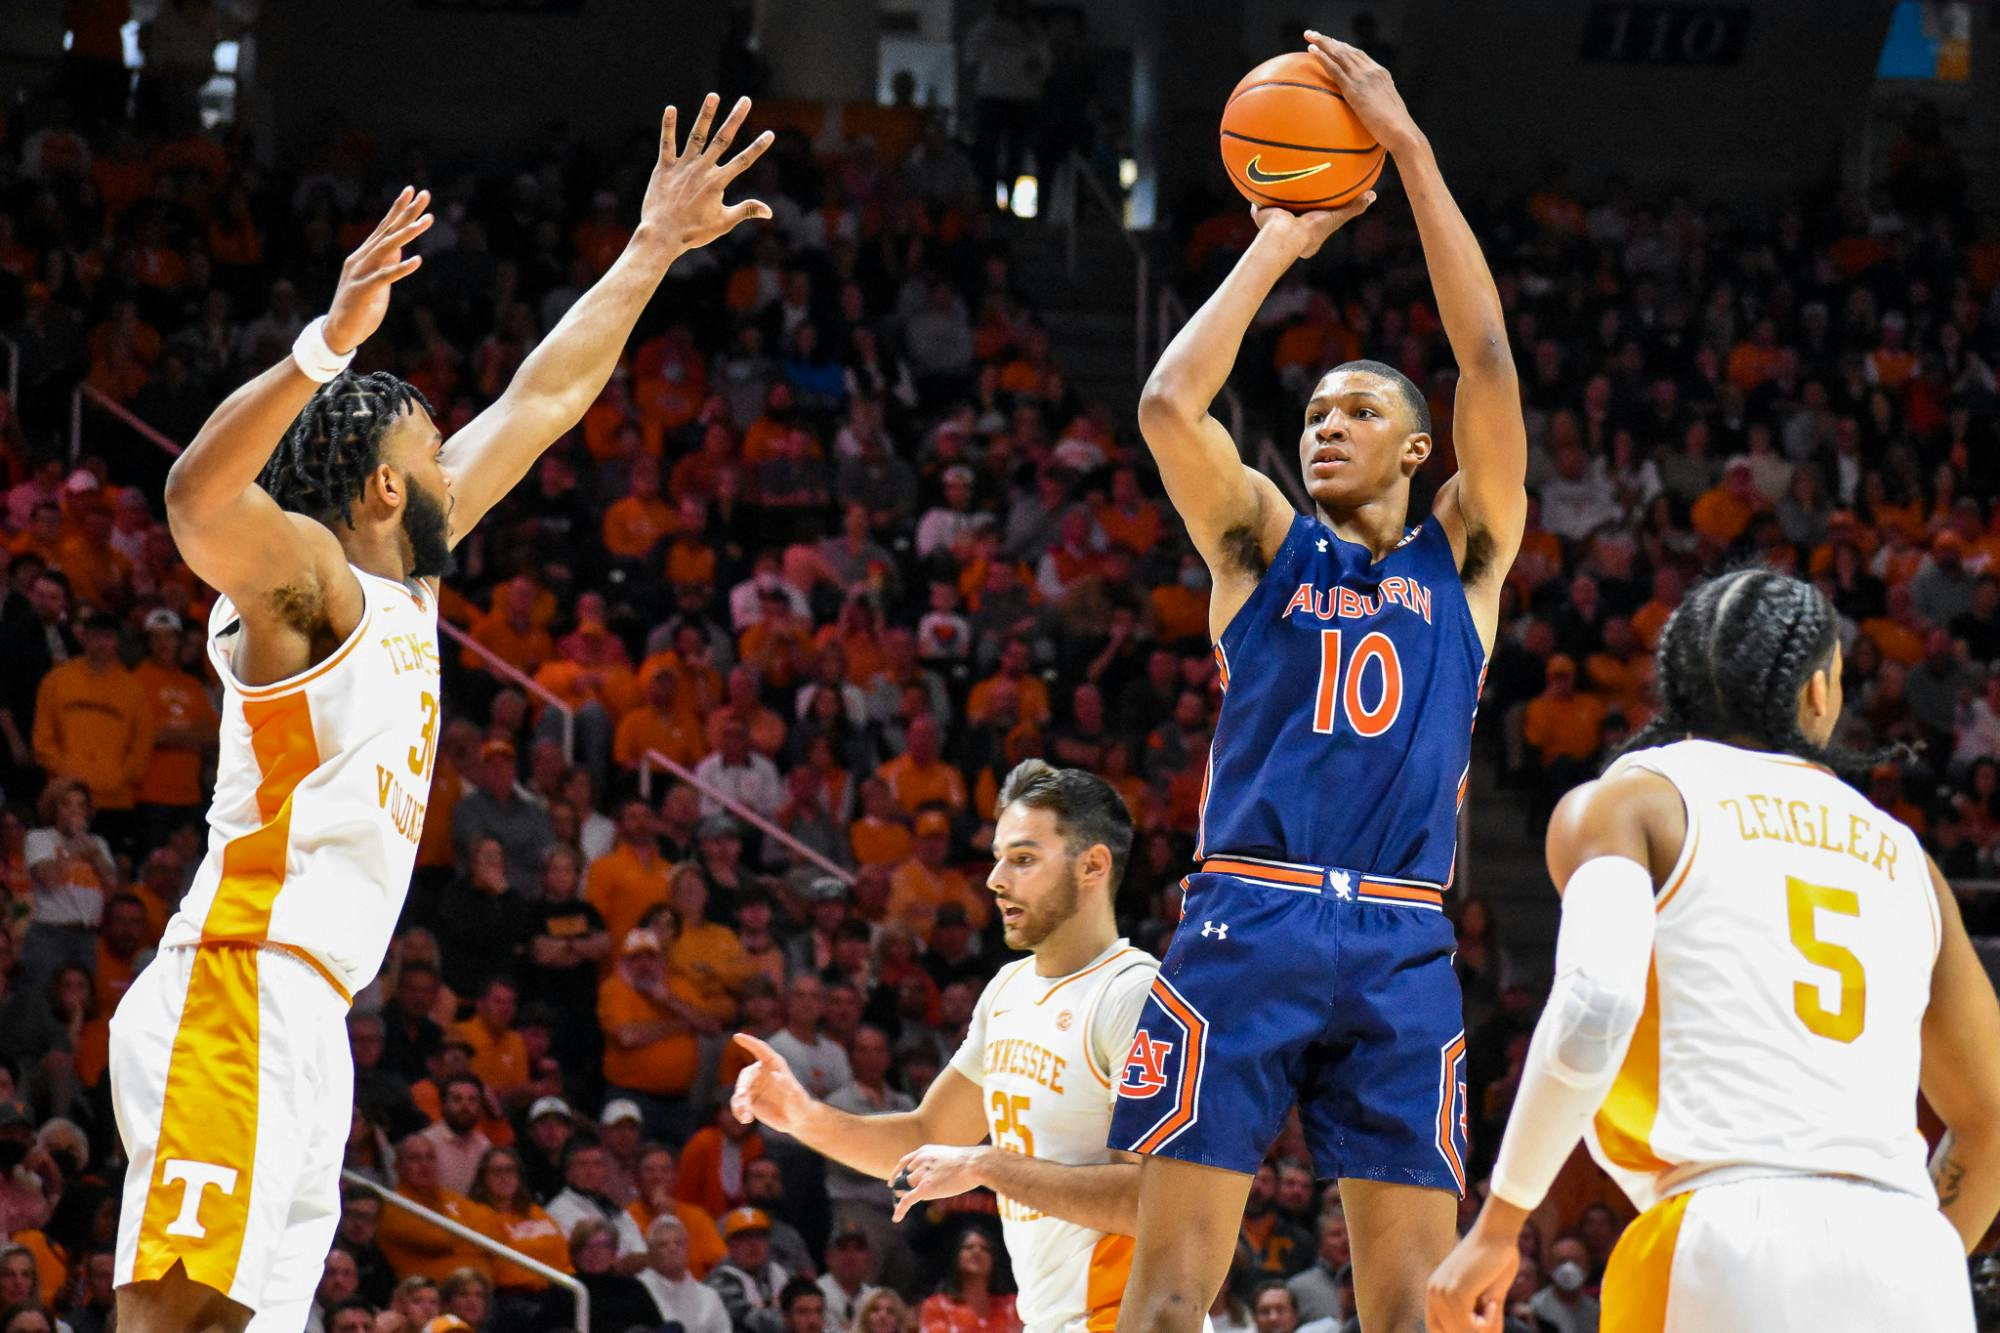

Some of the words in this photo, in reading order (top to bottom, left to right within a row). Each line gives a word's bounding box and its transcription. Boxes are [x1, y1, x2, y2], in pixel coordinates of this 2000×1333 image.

[1608, 9, 1726, 59] 110
[1281, 576, 1432, 625] AUBURN
[1312, 629, 1403, 737] 10
[1718, 794, 1898, 881] ZEIGLER
[1785, 875, 1866, 1044] 5
[991, 1091, 1034, 1158] 25
[162, 1158, 239, 1239] T
